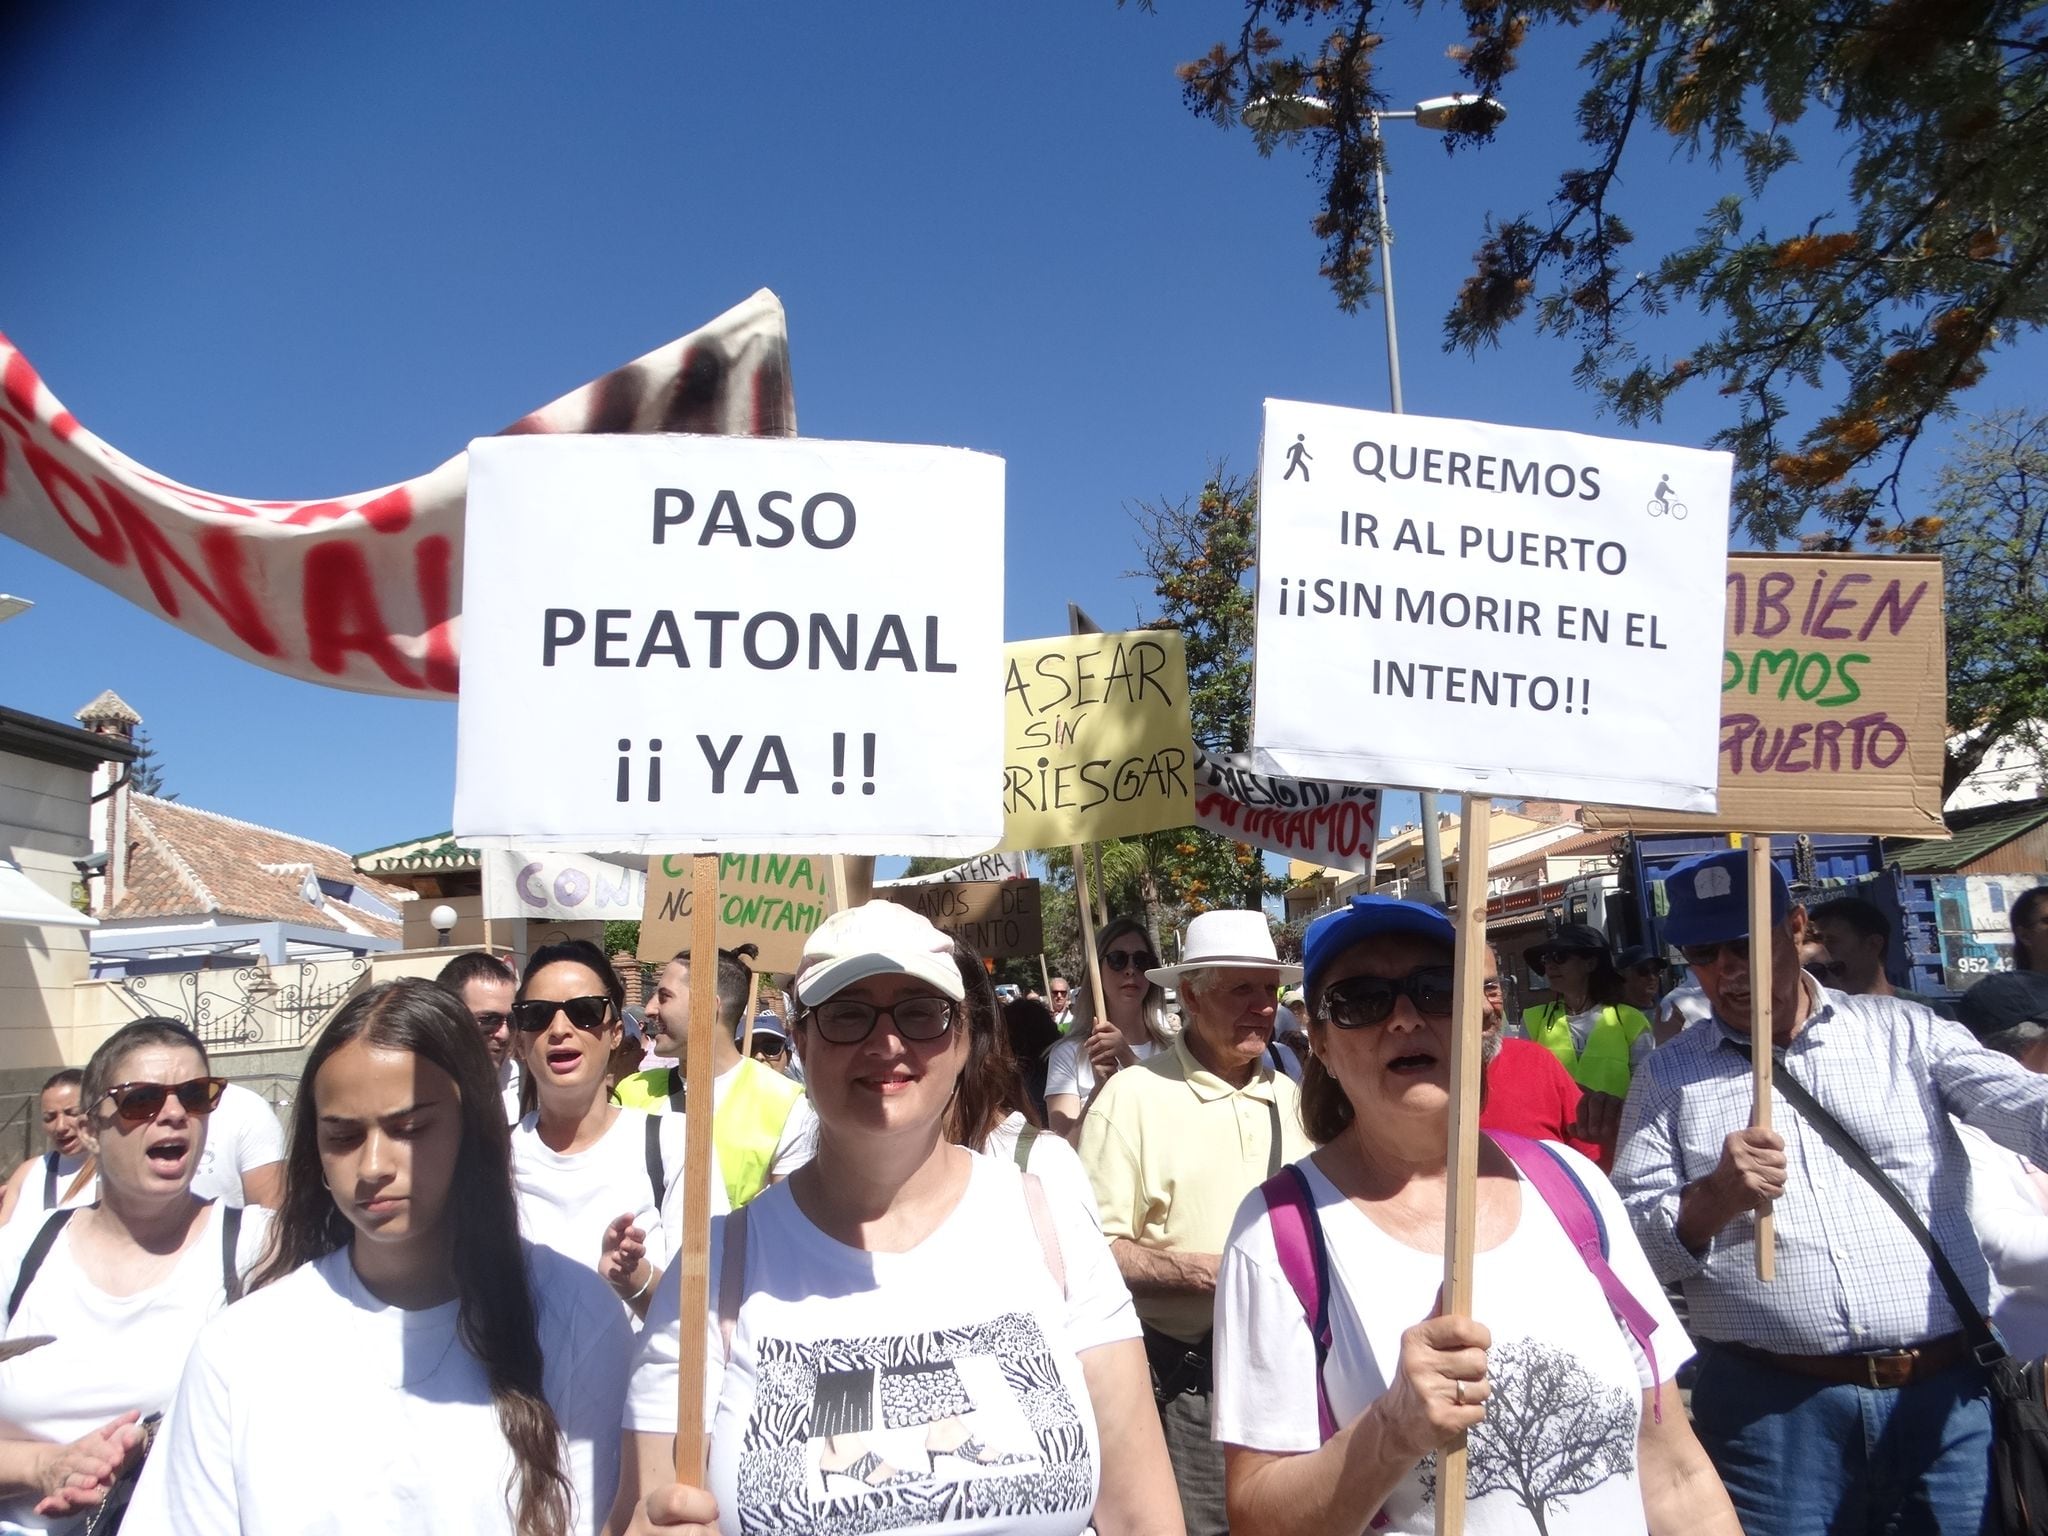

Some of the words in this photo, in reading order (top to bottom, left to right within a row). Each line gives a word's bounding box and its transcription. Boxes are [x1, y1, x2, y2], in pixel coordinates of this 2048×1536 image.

[1353, 440, 1601, 501] QUEREMOS
[652, 487, 857, 550] PASO
[1340, 510, 1379, 549] IR
[1393, 518, 1445, 556] AL
[1460, 525, 1627, 576] PUERTO
[542, 608, 957, 674] PEATONAL
[1279, 576, 1382, 620] ¡¡SIN
[1395, 587, 1541, 637] MORIR
[1557, 605, 1609, 644] EN
[1626, 612, 1667, 650] EL
[1005, 641, 1172, 716] ASEAR
[1372, 658, 1591, 716] INTENTO!!
[1721, 648, 1872, 708] OMOS
[695, 734, 799, 795] YA
[831, 732, 877, 796] !!
[515, 861, 647, 909] CON
[1001, 885, 1031, 916] DE
[1958, 957, 1989, 973] 952
[1994, 957, 2016, 973] 42
